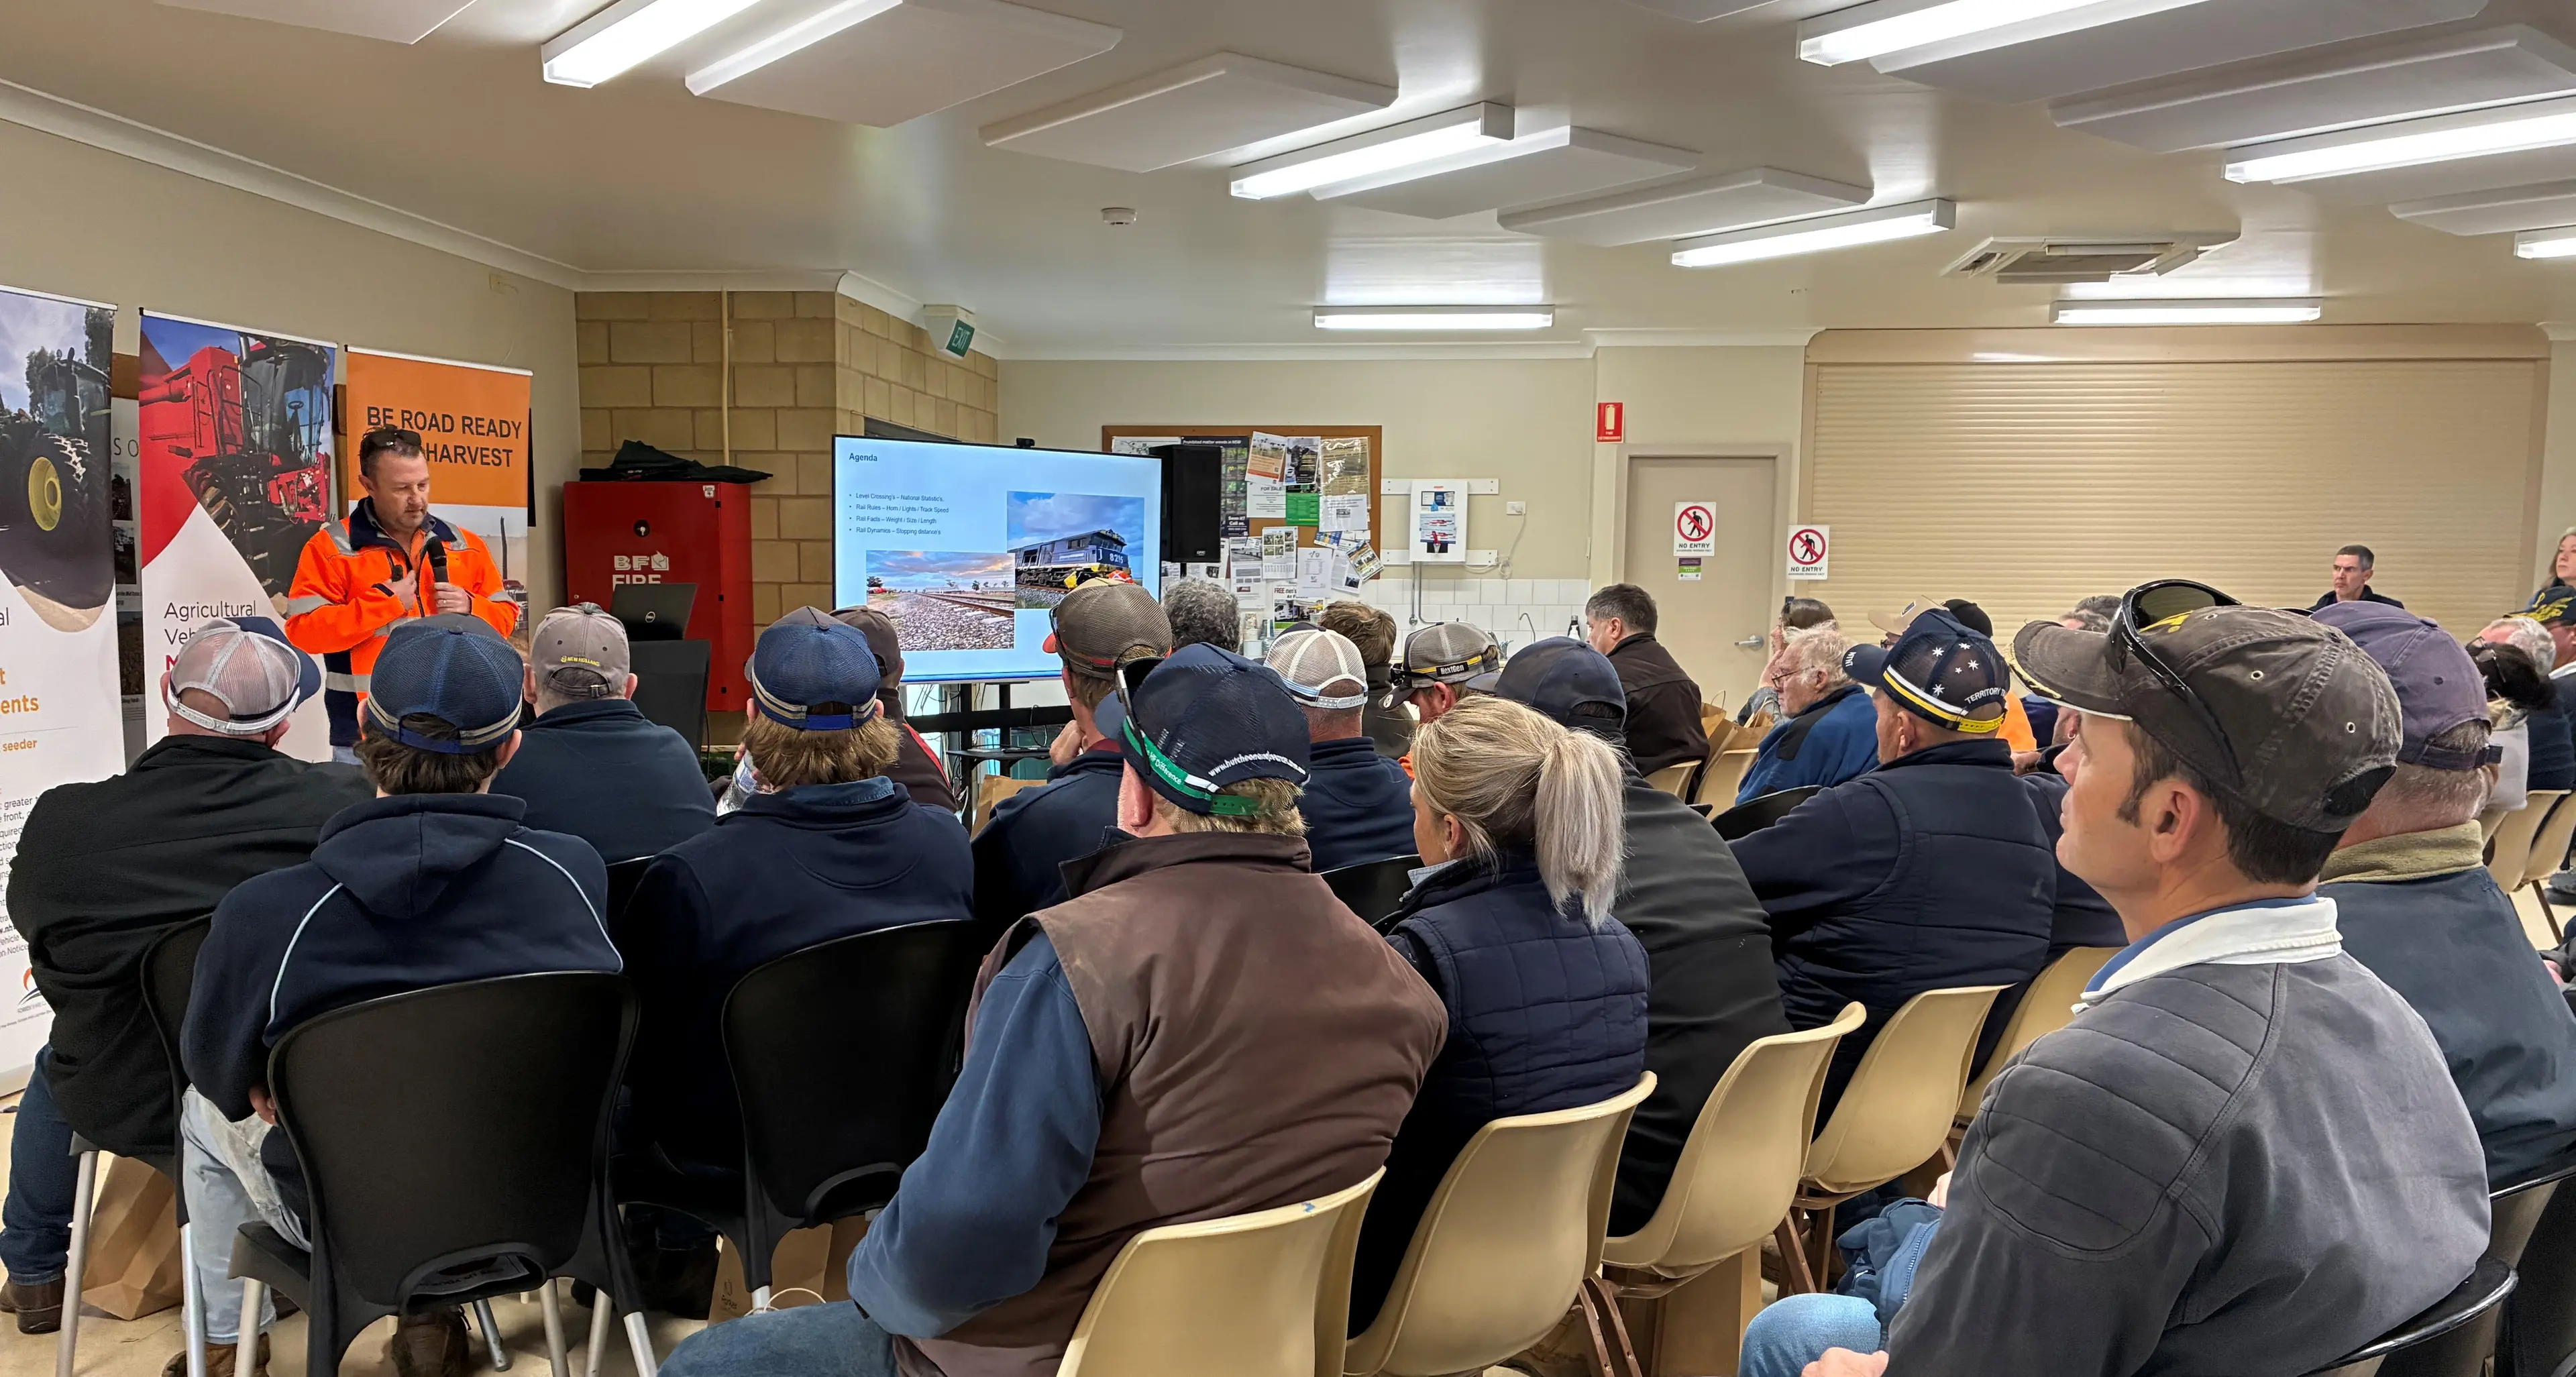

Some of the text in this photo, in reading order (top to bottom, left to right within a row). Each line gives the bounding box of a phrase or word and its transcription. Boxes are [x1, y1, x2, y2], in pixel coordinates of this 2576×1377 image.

[952, 327, 970, 350] EXIT
[367, 406, 522, 440] BE ROAD READY
[425, 442, 513, 467] HARVEST
[849, 453, 877, 462] Agenda
[164, 600, 256, 622] Agricultural
[1964, 687, 2002, 704] TERRITORY
[2, 738, 38, 753] seeder
[1155, 759, 1182, 785] Difference
[4, 796, 33, 810] greater
[3, 811, 24, 822] front,
